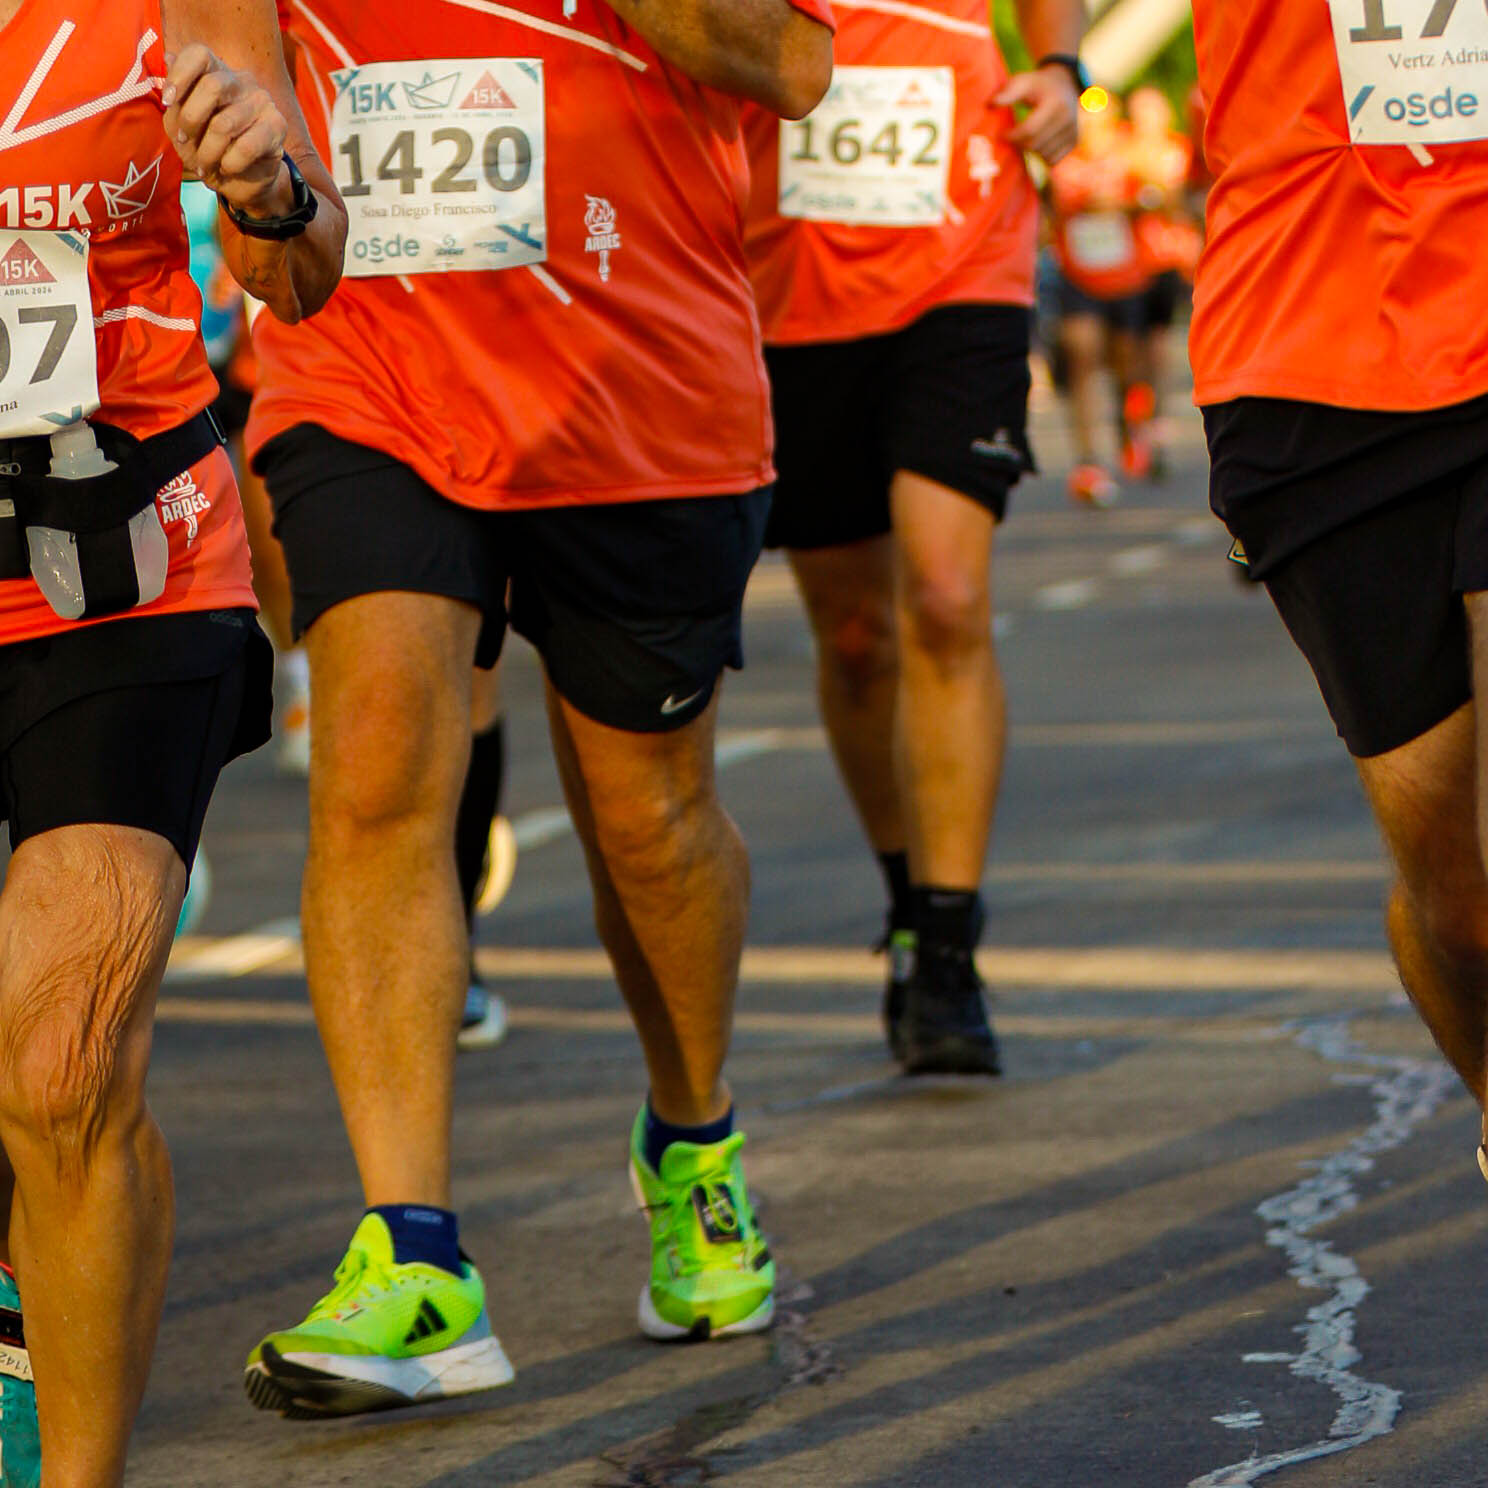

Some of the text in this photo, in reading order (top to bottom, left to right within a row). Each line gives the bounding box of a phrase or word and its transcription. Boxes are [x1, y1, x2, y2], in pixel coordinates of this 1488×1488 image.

[1388, 53, 1435, 69] Vertz
[350, 81, 397, 114] 15K
[472, 88, 504, 104] 15K
[1384, 85, 1479, 124] osde
[790, 118, 940, 167] 1642
[339, 125, 532, 197] 1420
[0, 183, 95, 228] 15K
[391, 204, 429, 220] Diego
[433, 203, 497, 216] Francisco
[97, 213, 144, 234] ORTE
[353, 233, 420, 262] osde
[1, 259, 39, 280] 15K
[4, 287, 29, 297] ABRIL
[0, 304, 78, 385] 7
[161, 492, 211, 525] ARDEC
